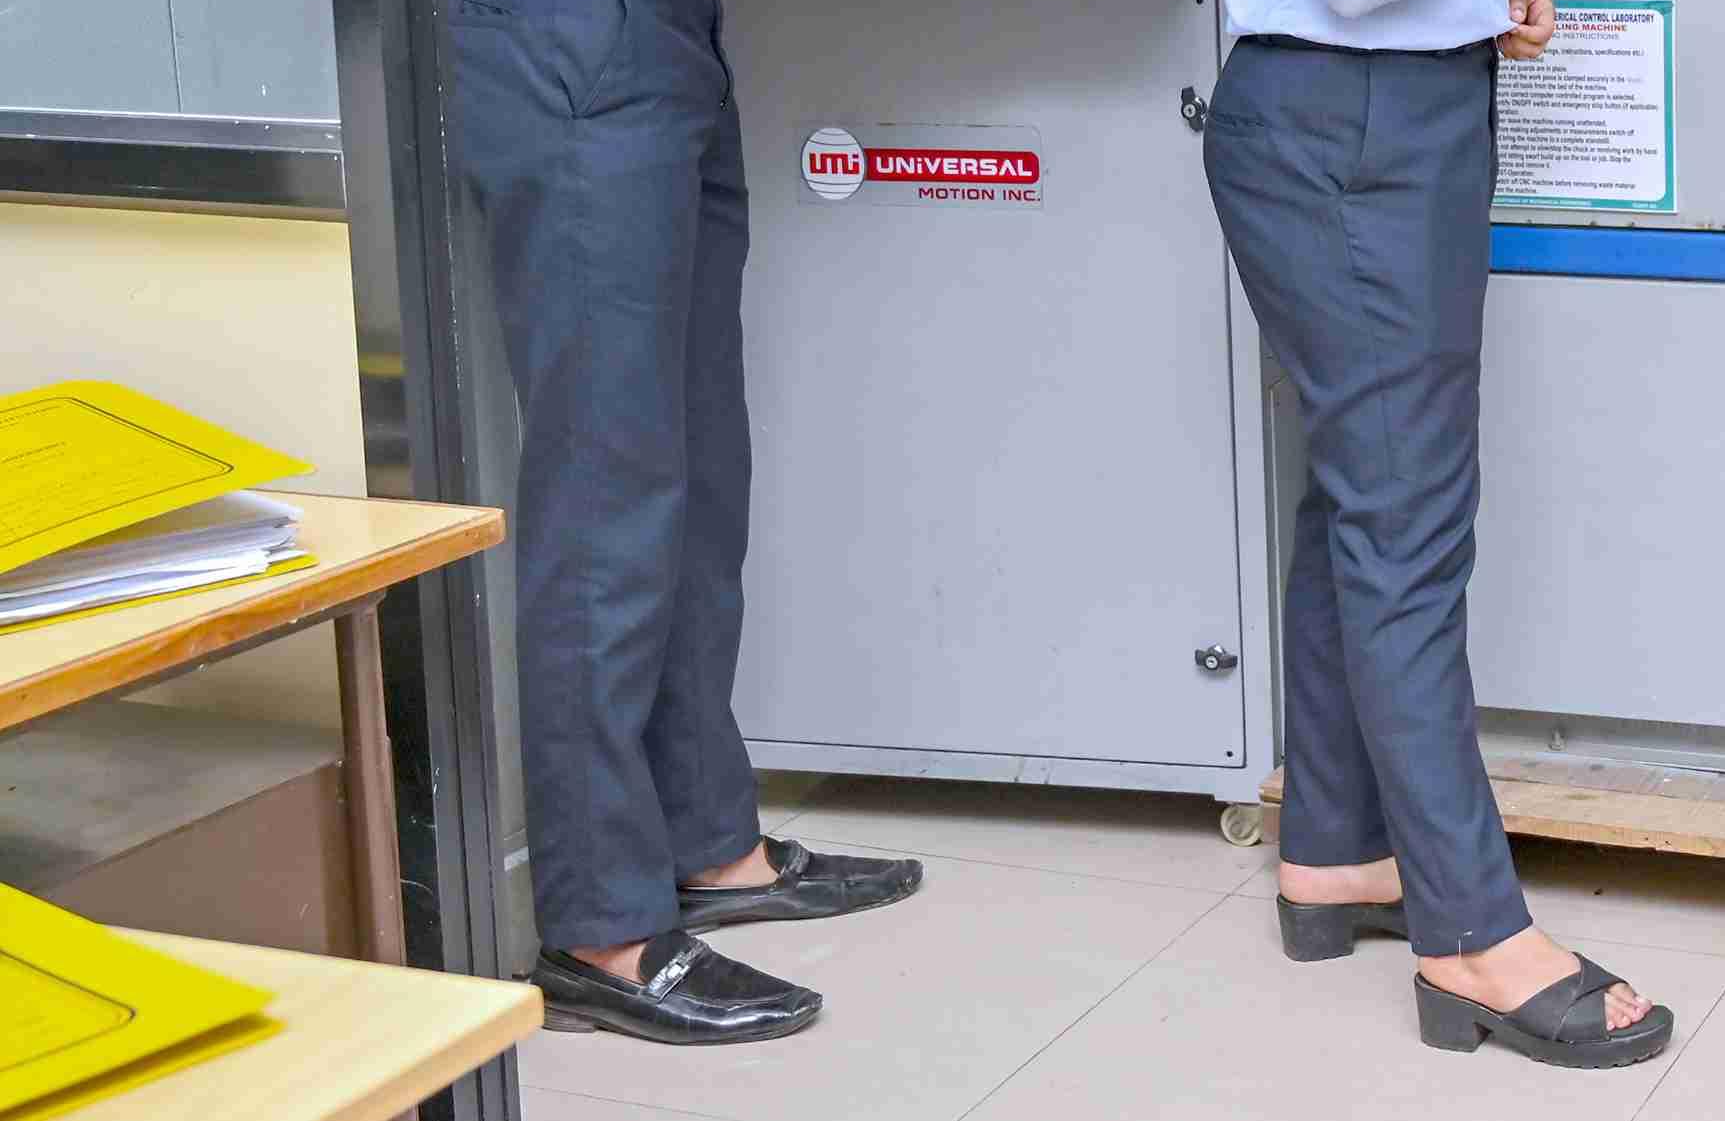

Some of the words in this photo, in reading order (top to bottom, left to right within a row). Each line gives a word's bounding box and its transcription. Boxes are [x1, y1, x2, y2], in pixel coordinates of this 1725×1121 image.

[1554, 13, 1578, 21] ERICAL
[1579, 13, 1609, 22] CONTROL
[1611, 14, 1654, 24] LABORATORY
[1582, 24, 1627, 32] MACHINE
[919, 187, 994, 200] MOTION
[1003, 189, 1041, 202] INC.
